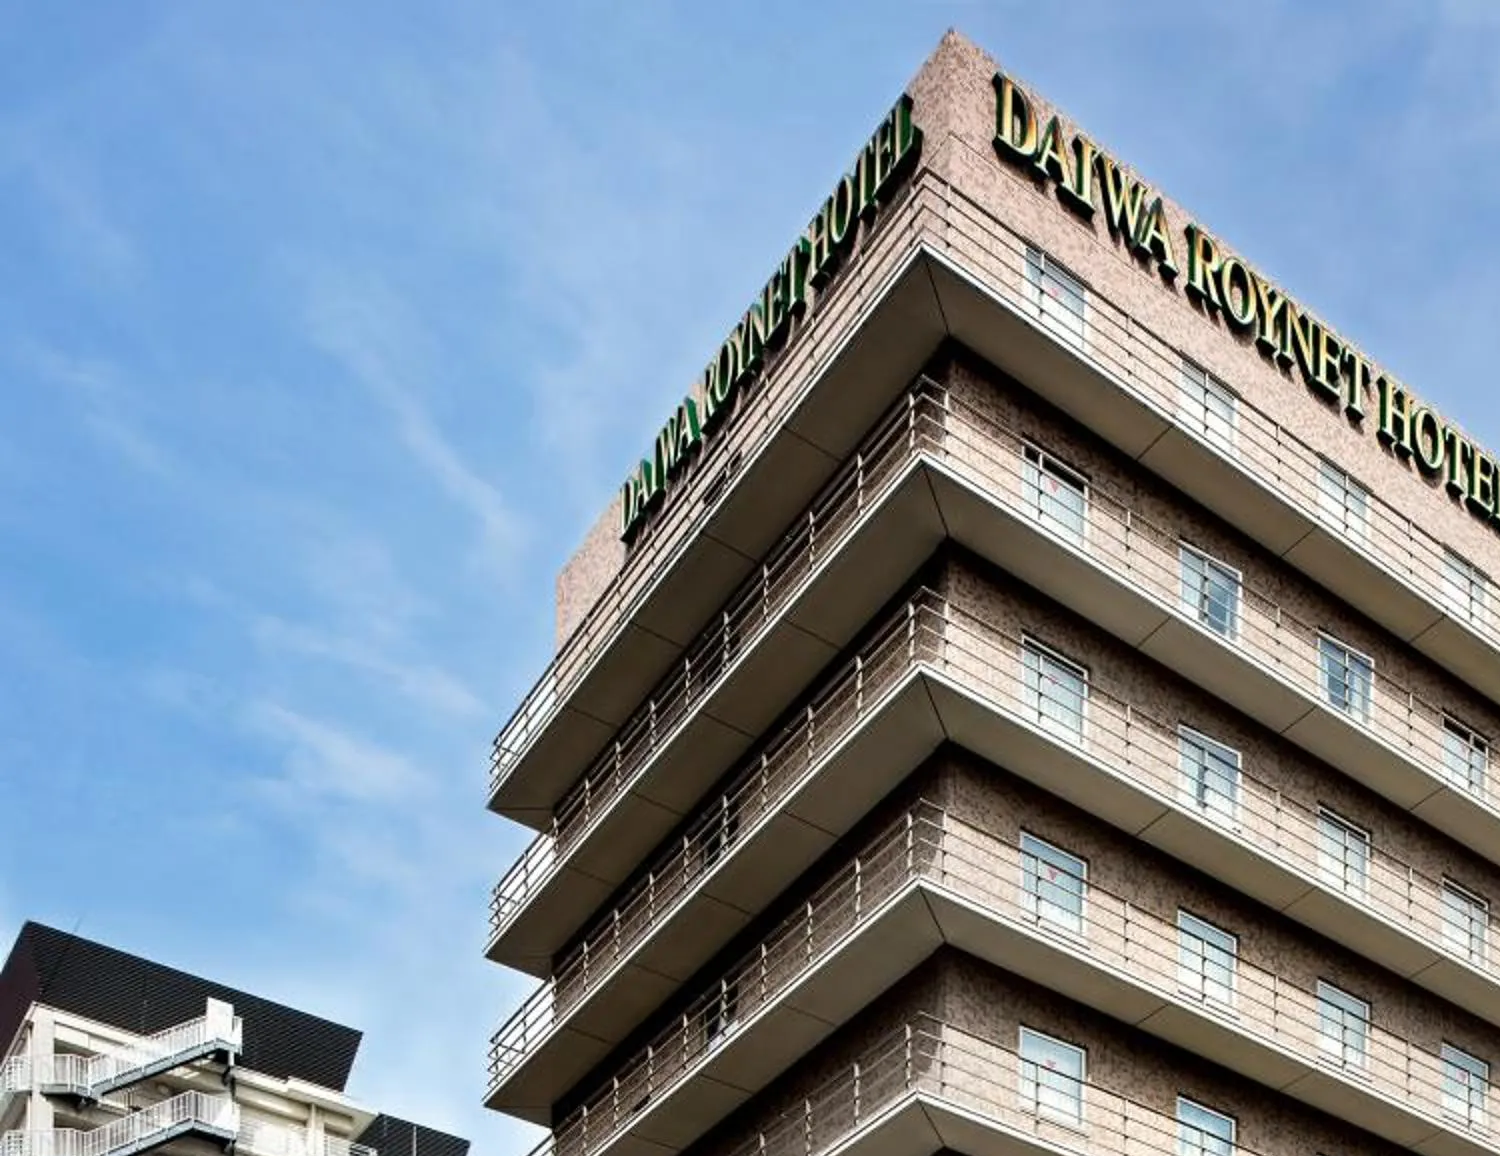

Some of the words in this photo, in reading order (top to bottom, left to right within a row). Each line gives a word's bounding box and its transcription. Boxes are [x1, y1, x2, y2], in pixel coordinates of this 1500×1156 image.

[619, 395, 702, 543] DAIWA
[700, 236, 811, 434] ROYNET
[807, 94, 922, 287] HOTEL
[992, 72, 1179, 283] DAIWA
[1184, 221, 1373, 422] ROYNET
